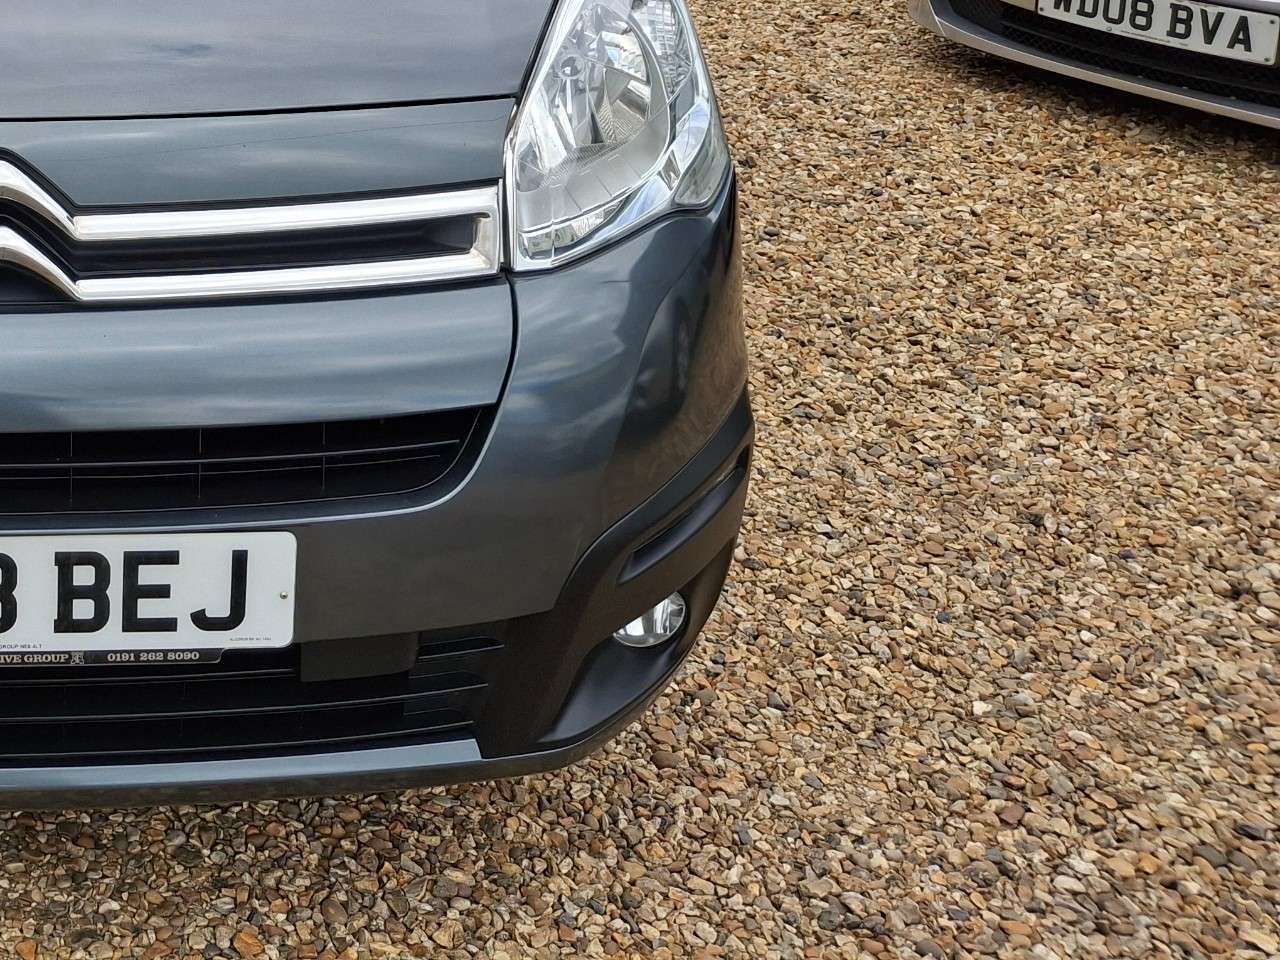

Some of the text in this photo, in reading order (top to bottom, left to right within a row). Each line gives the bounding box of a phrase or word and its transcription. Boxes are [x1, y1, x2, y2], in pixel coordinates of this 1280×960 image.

[1166, 2, 1253, 53] BVA
[53, 549, 249, 633] BEJ
[23, 653, 69, 664] GROUP
[106, 653, 135, 662] 0191
[139, 652, 164, 661] 262
[166, 651, 200, 661] 8090
